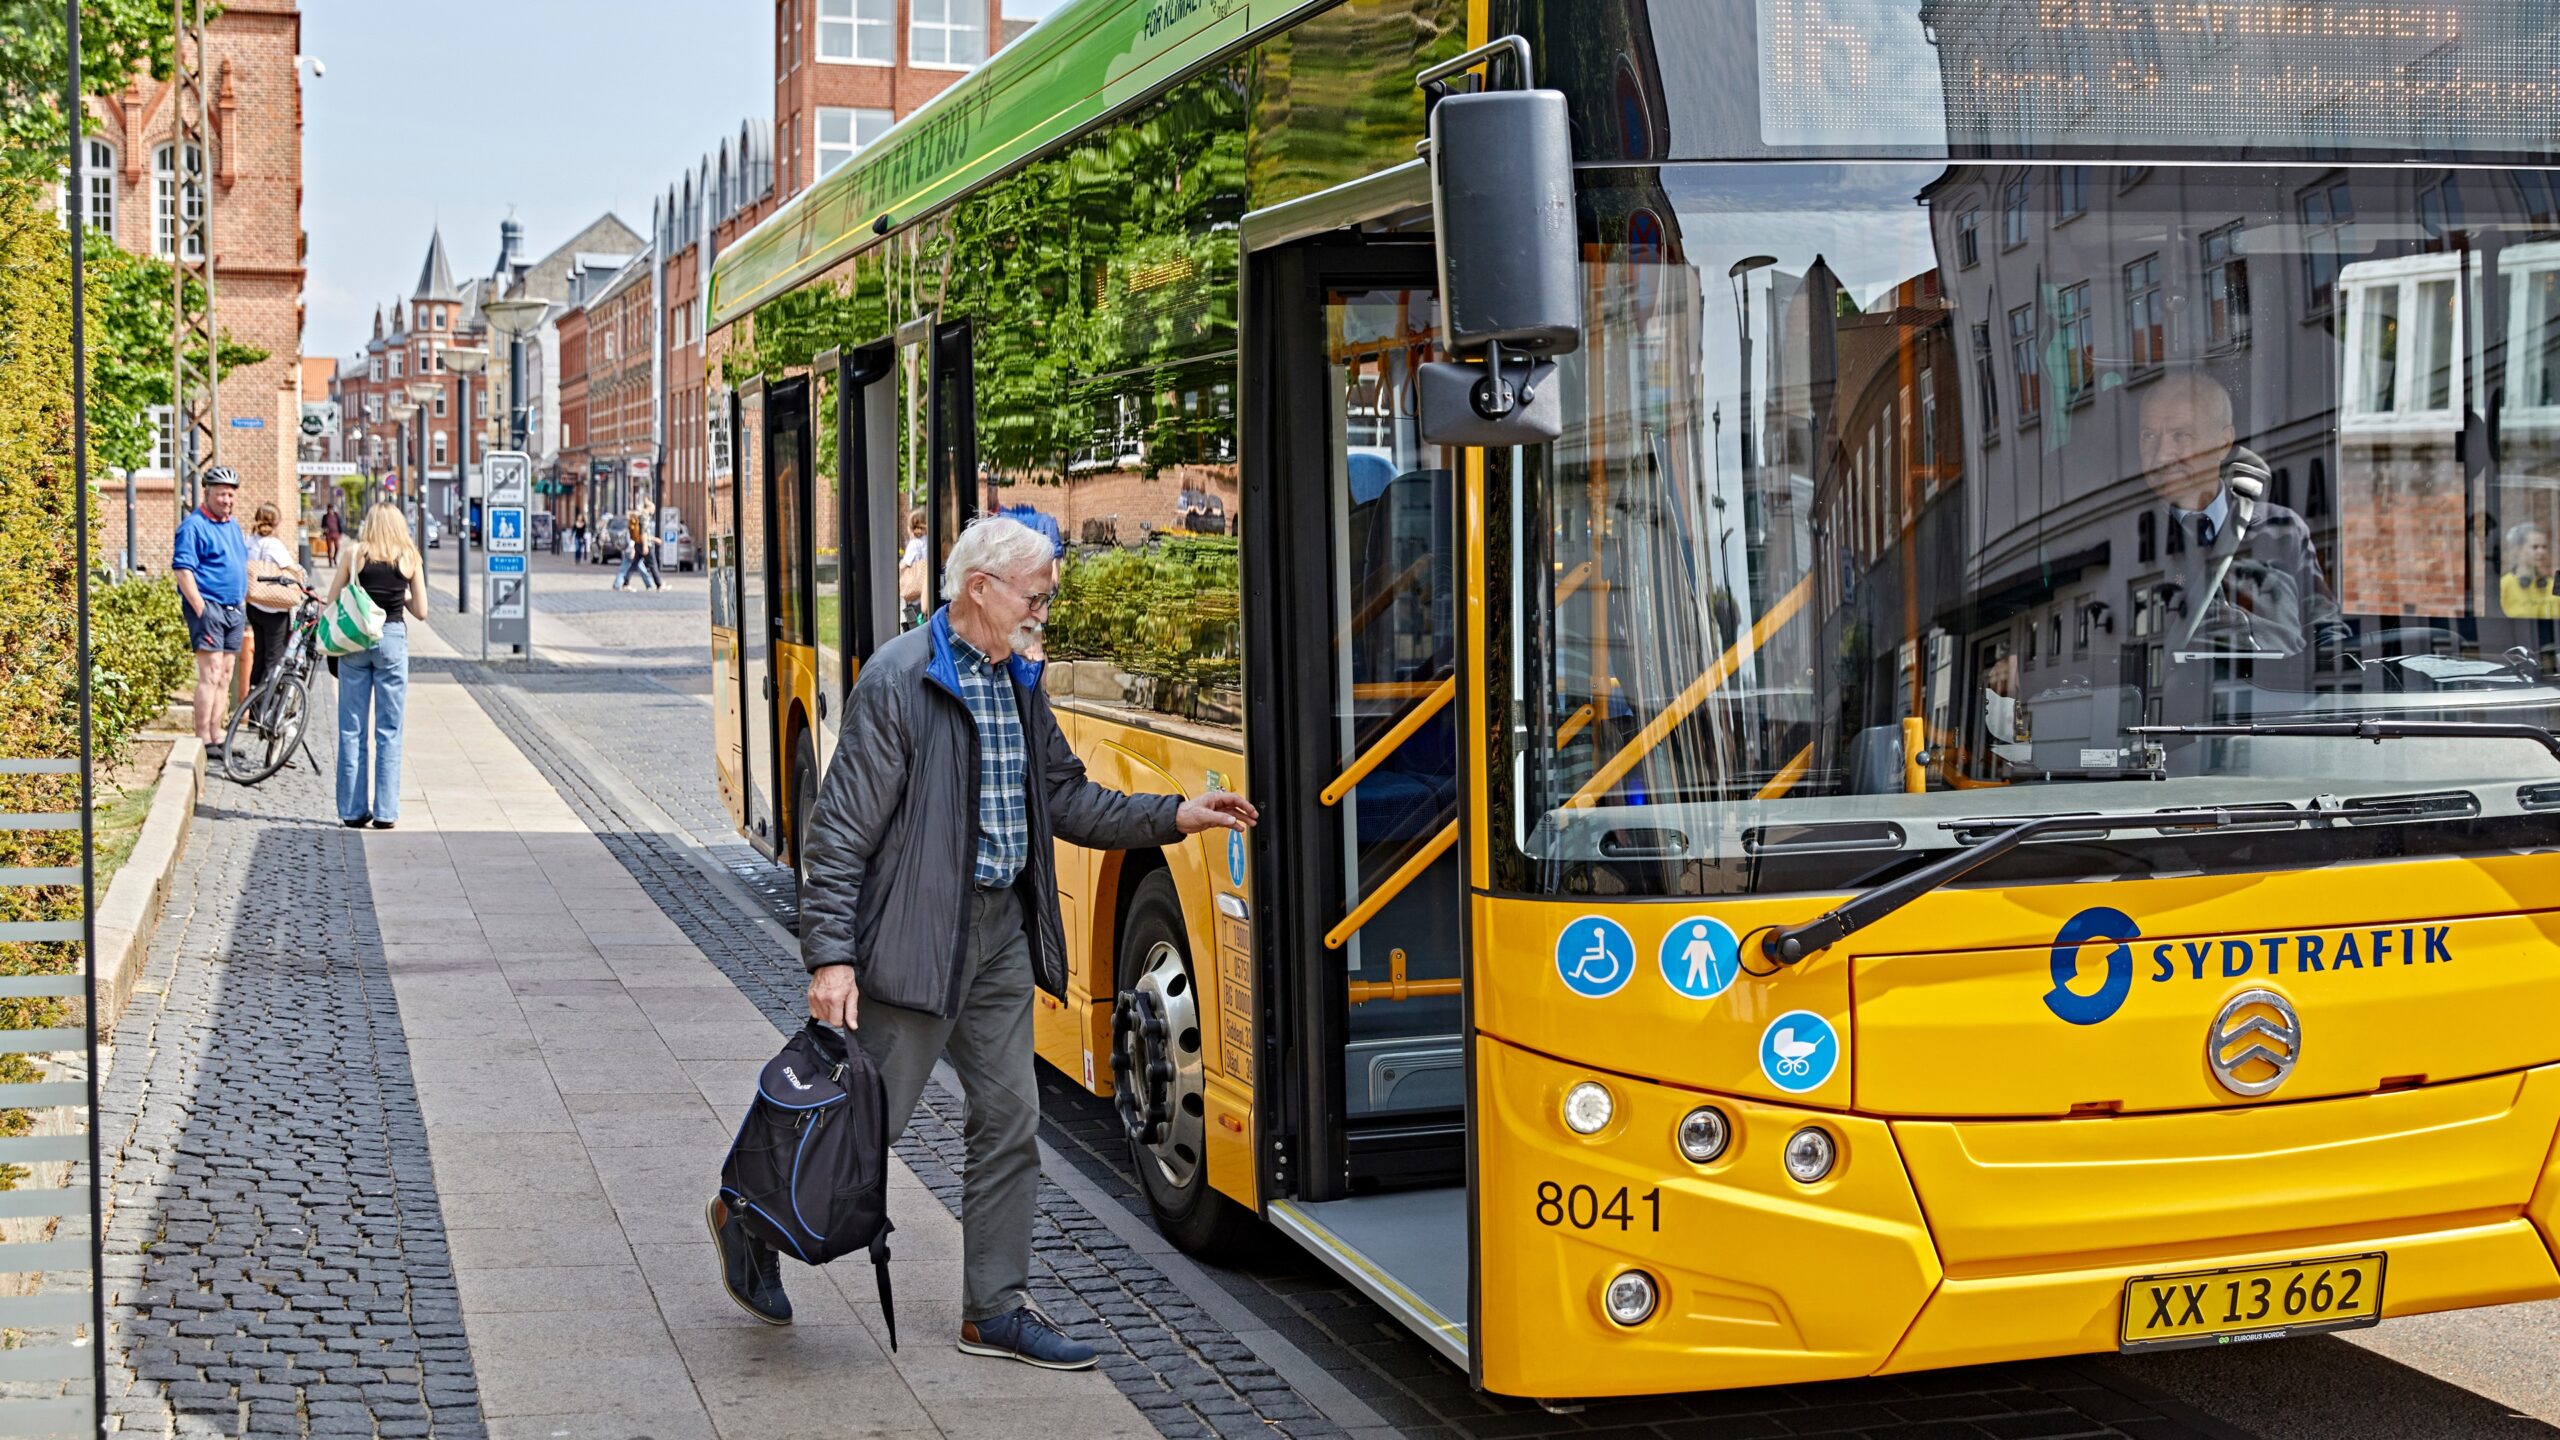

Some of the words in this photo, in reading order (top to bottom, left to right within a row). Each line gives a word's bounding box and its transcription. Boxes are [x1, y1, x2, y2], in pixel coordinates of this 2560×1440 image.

[1144, 5, 1162, 41] FOR
[868, 155, 889, 215] ER
[891, 135, 914, 202] EN
[916, 95, 973, 184] ELBUS
[494, 467, 519, 484] 30
[2151, 926, 2453, 982] SYDTRAFIK
[1225, 983, 1233, 1007] BG
[1536, 1181, 1660, 1232] 8041
[2146, 1283, 2208, 1329] XX
[2222, 1277, 2271, 1323] 13
[2284, 1267, 2361, 1316] 662
[2234, 1333, 2262, 1342] EUROBUS
[2263, 1331, 2287, 1339] NORDIC
